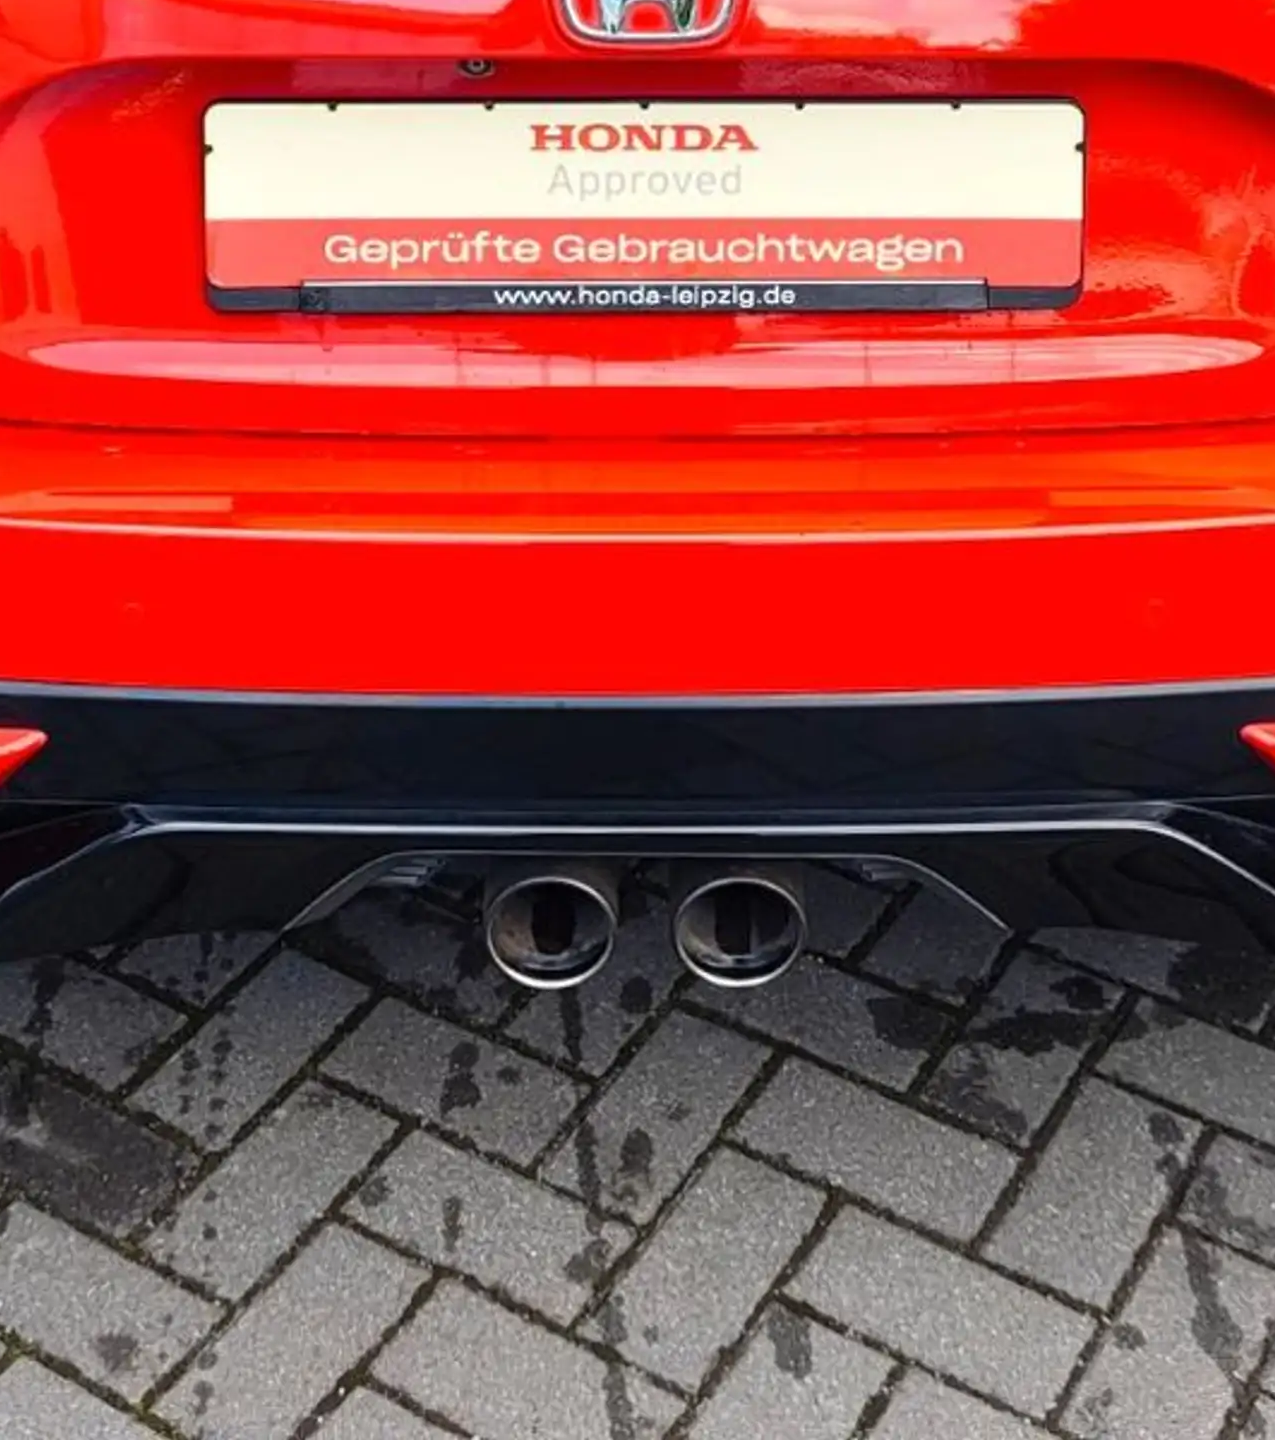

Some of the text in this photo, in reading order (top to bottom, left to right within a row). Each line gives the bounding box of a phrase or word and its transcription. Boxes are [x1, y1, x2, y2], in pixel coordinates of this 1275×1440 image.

[529, 124, 759, 152] HONDA
[548, 164, 743, 202] Approved
[325, 231, 962, 271] Geprüfte Gebrauchtwagen
[493, 285, 796, 308] www.honda-leipzig.de
